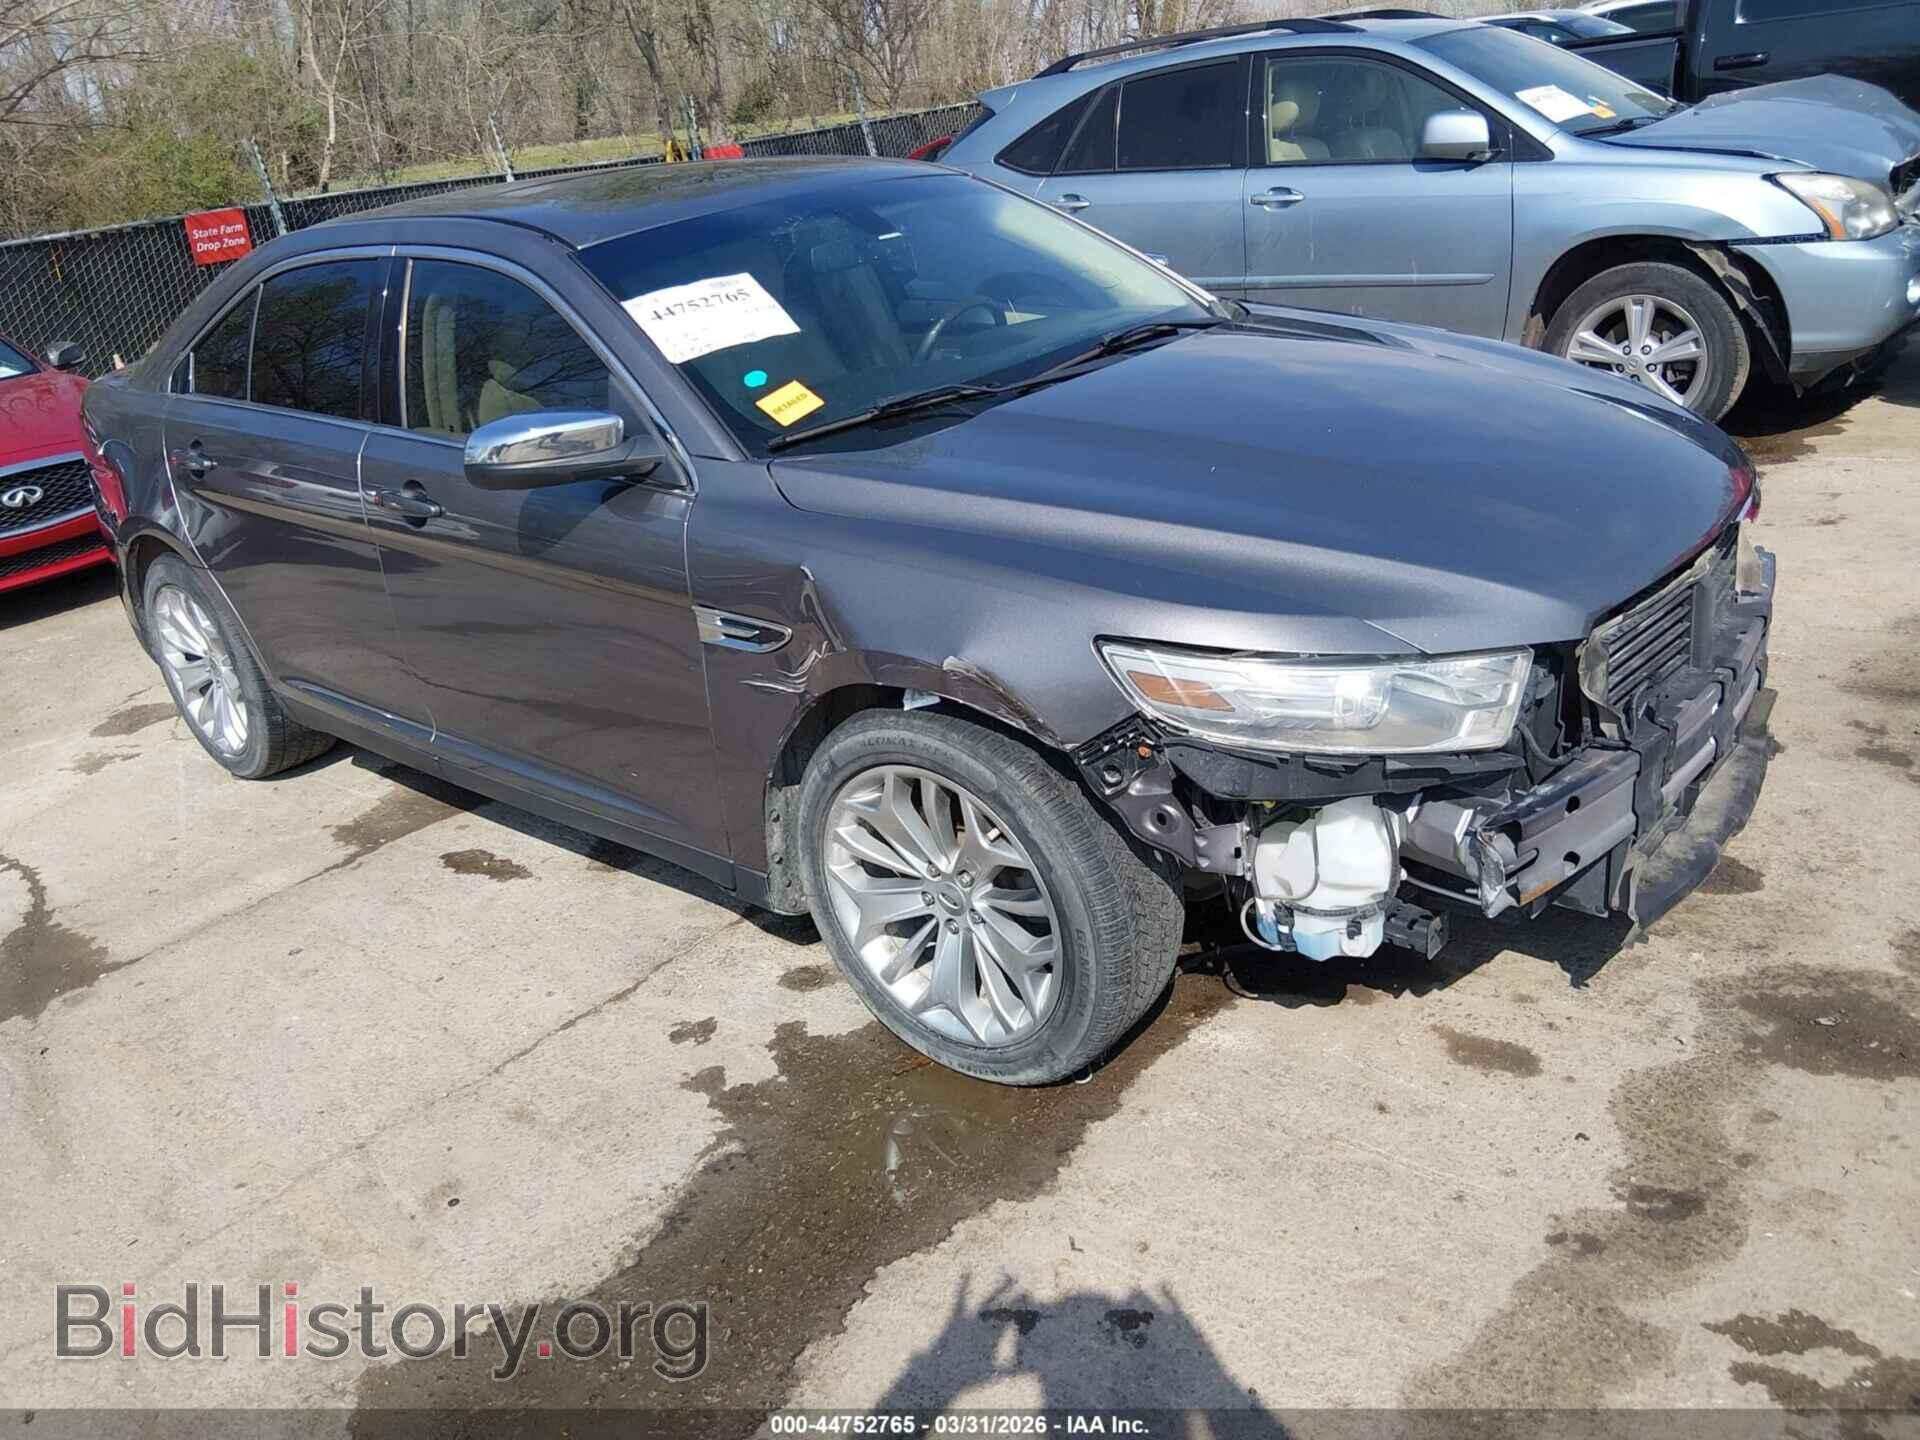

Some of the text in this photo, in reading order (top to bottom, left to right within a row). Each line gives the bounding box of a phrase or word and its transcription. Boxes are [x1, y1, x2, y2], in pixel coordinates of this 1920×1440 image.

[192, 224, 243, 239] State Farm
[196, 237, 246, 252] Drop Zone
[651, 288, 751, 321] 44752765
